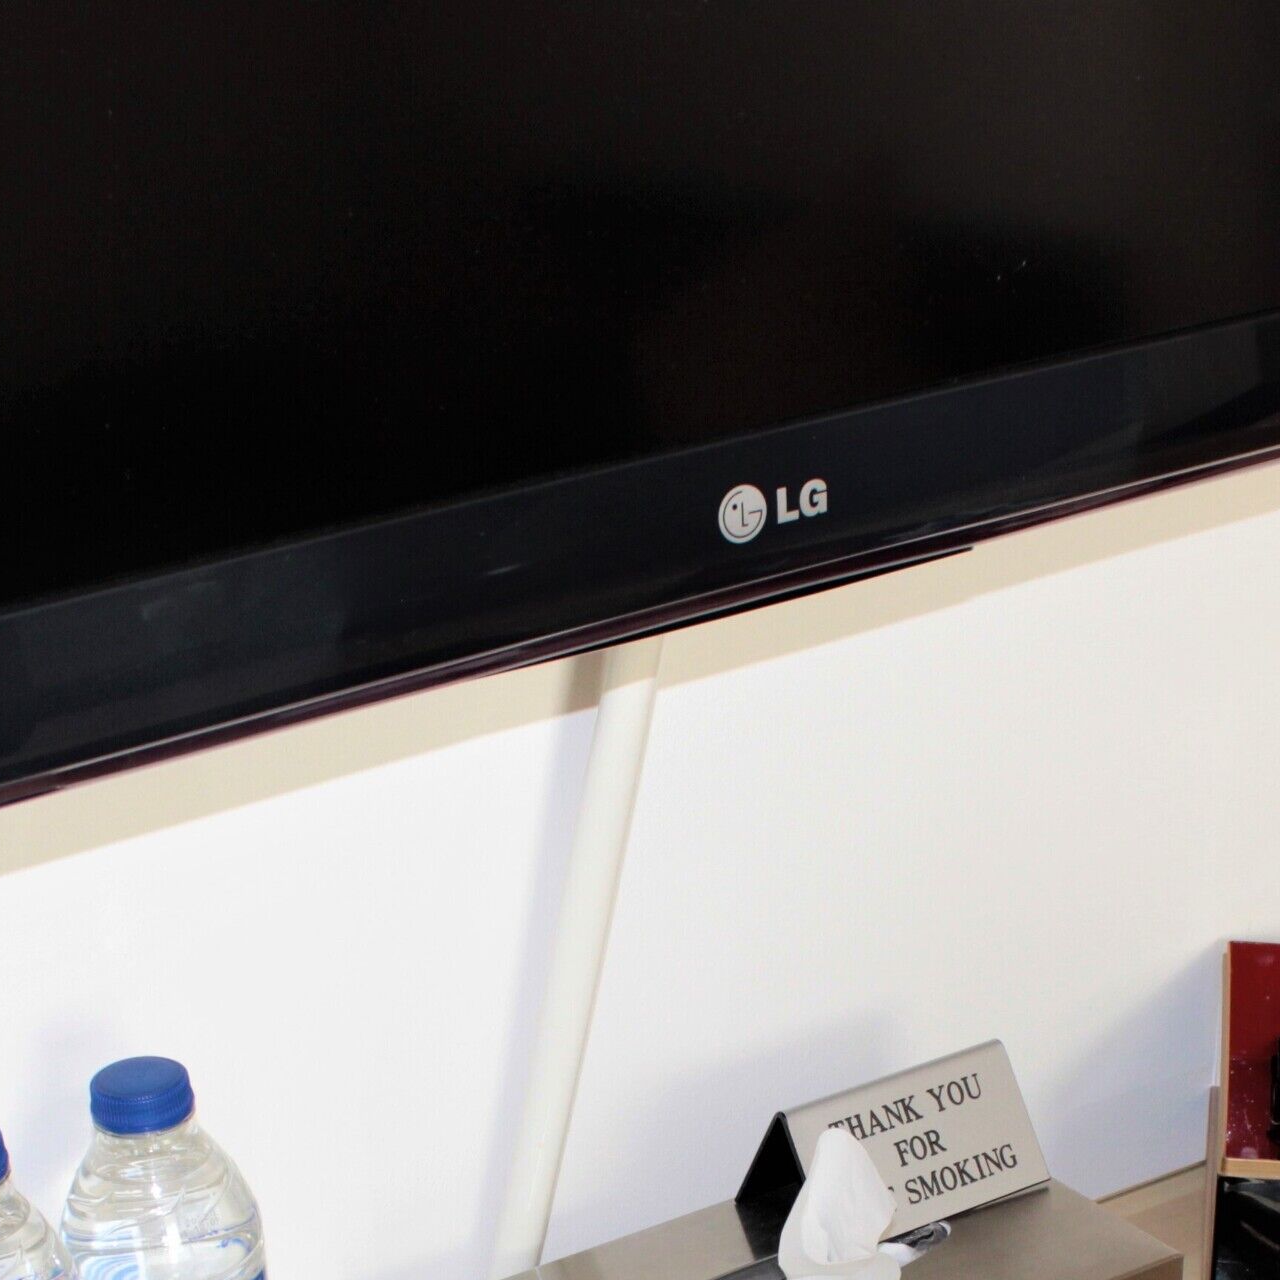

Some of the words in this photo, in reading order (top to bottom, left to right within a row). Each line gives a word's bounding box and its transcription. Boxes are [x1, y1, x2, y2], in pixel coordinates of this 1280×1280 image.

[776, 478, 828, 524] LG
[927, 1073, 982, 1112] YOU
[893, 1129, 947, 1167] FOR
[904, 1144, 1018, 1205] SMOKING
